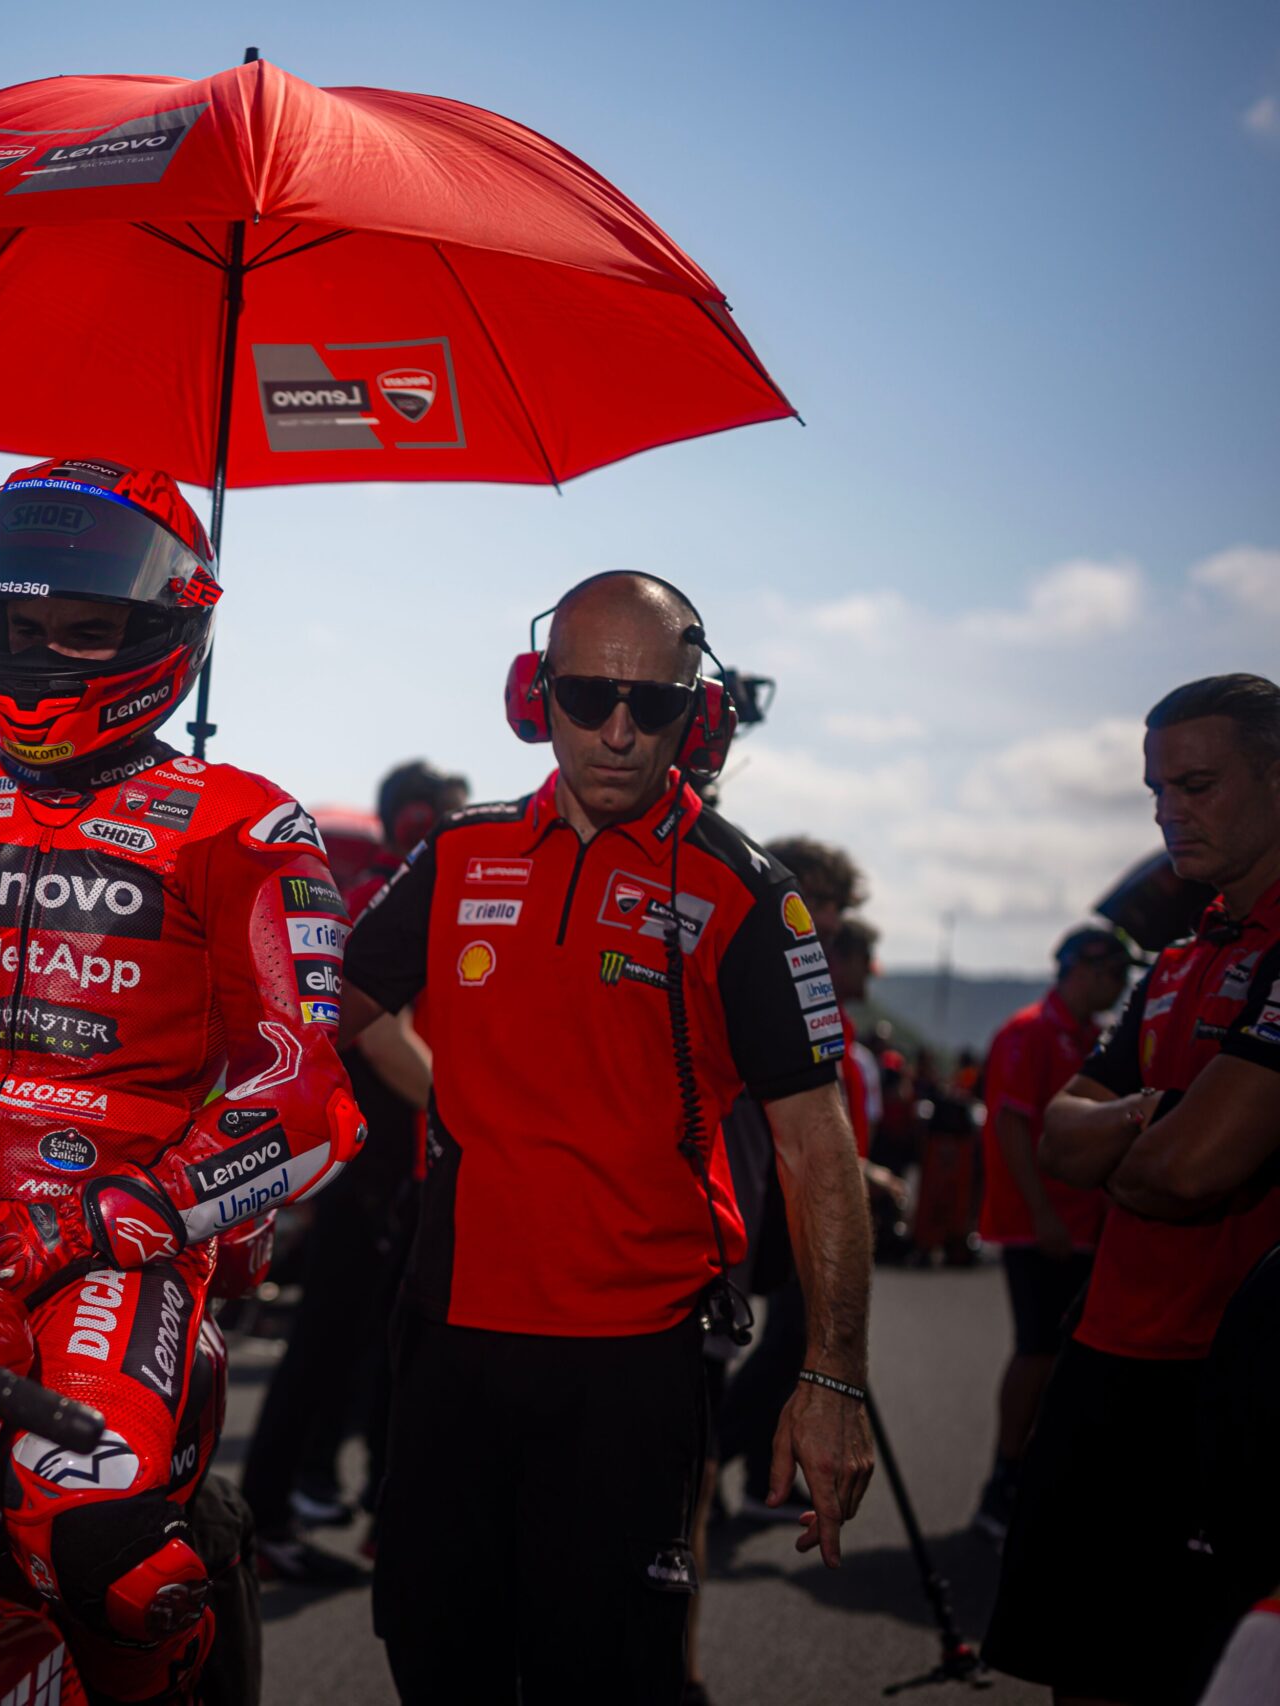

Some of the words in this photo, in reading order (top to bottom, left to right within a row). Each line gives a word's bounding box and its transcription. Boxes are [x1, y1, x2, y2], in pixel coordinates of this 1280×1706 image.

[50, 135, 167, 161] Lenovo
[7, 479, 42, 490] Estrella
[44, 479, 81, 491] Galicia
[11, 503, 83, 530] SHOEI
[106, 685, 170, 724] Lenovo
[90, 754, 155, 786] Lenovo
[155, 769, 205, 788] motorola
[153, 801, 189, 817] Lenovo
[90, 823, 147, 848] SHOEI
[476, 903, 515, 920] riello
[651, 902, 697, 932] Lenvo
[0, 1031, 91, 1051] ENERGY
[48, 1137, 89, 1155] Estrella
[48, 1147, 86, 1164] Galicia
[197, 1142, 281, 1192] Lenovo
[219, 1168, 289, 1214] Unipol
[67, 1269, 126, 1362] DUCA
[141, 1279, 185, 1398] Lenovo
